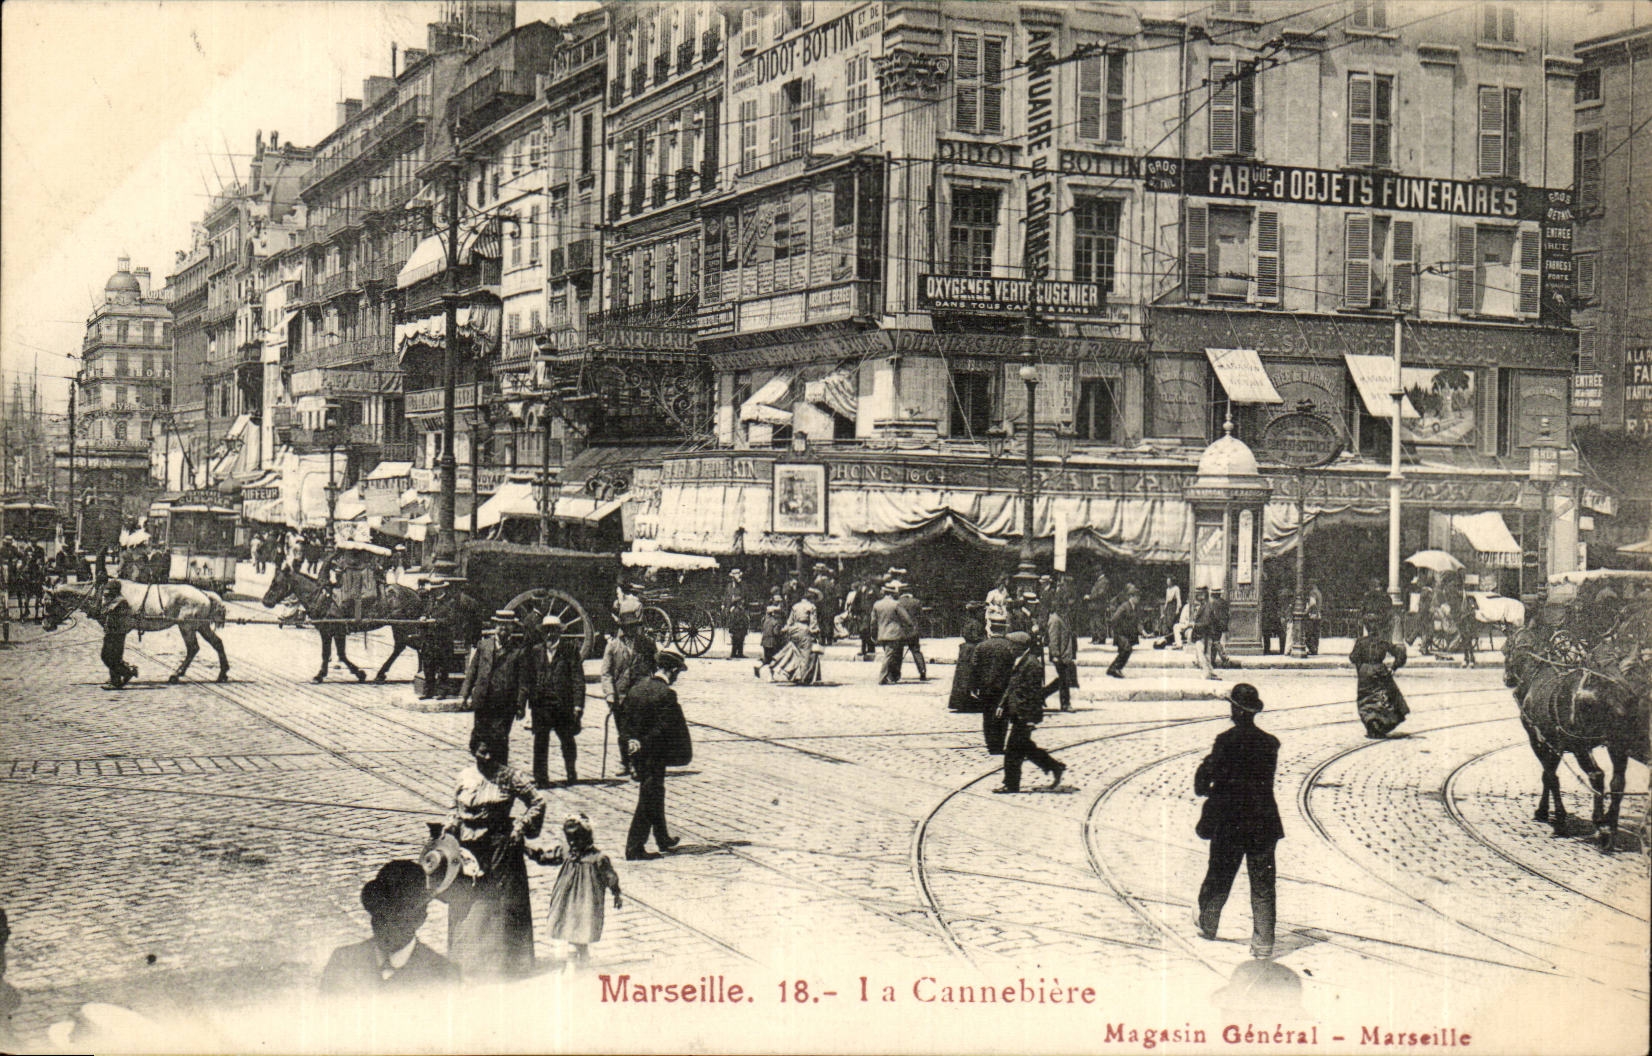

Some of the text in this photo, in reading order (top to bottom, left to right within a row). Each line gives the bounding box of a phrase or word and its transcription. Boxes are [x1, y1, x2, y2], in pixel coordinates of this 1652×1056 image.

[1027, 30, 1054, 156] ANNUAIRE
[938, 143, 1141, 177] DIDOT BOTTIN
[1148, 160, 1177, 175] GROS
[1382, 177, 1518, 216] FUNÉRAIRES
[1548, 191, 1572, 205] GROS
[994, 279, 1032, 303] VERTE
[1037, 281, 1099, 307] CUSENIER
[971, 302, 1000, 310] TOUS
[1006, 304, 1042, 312] CAFS
[1058, 306, 1089, 314] BARS
